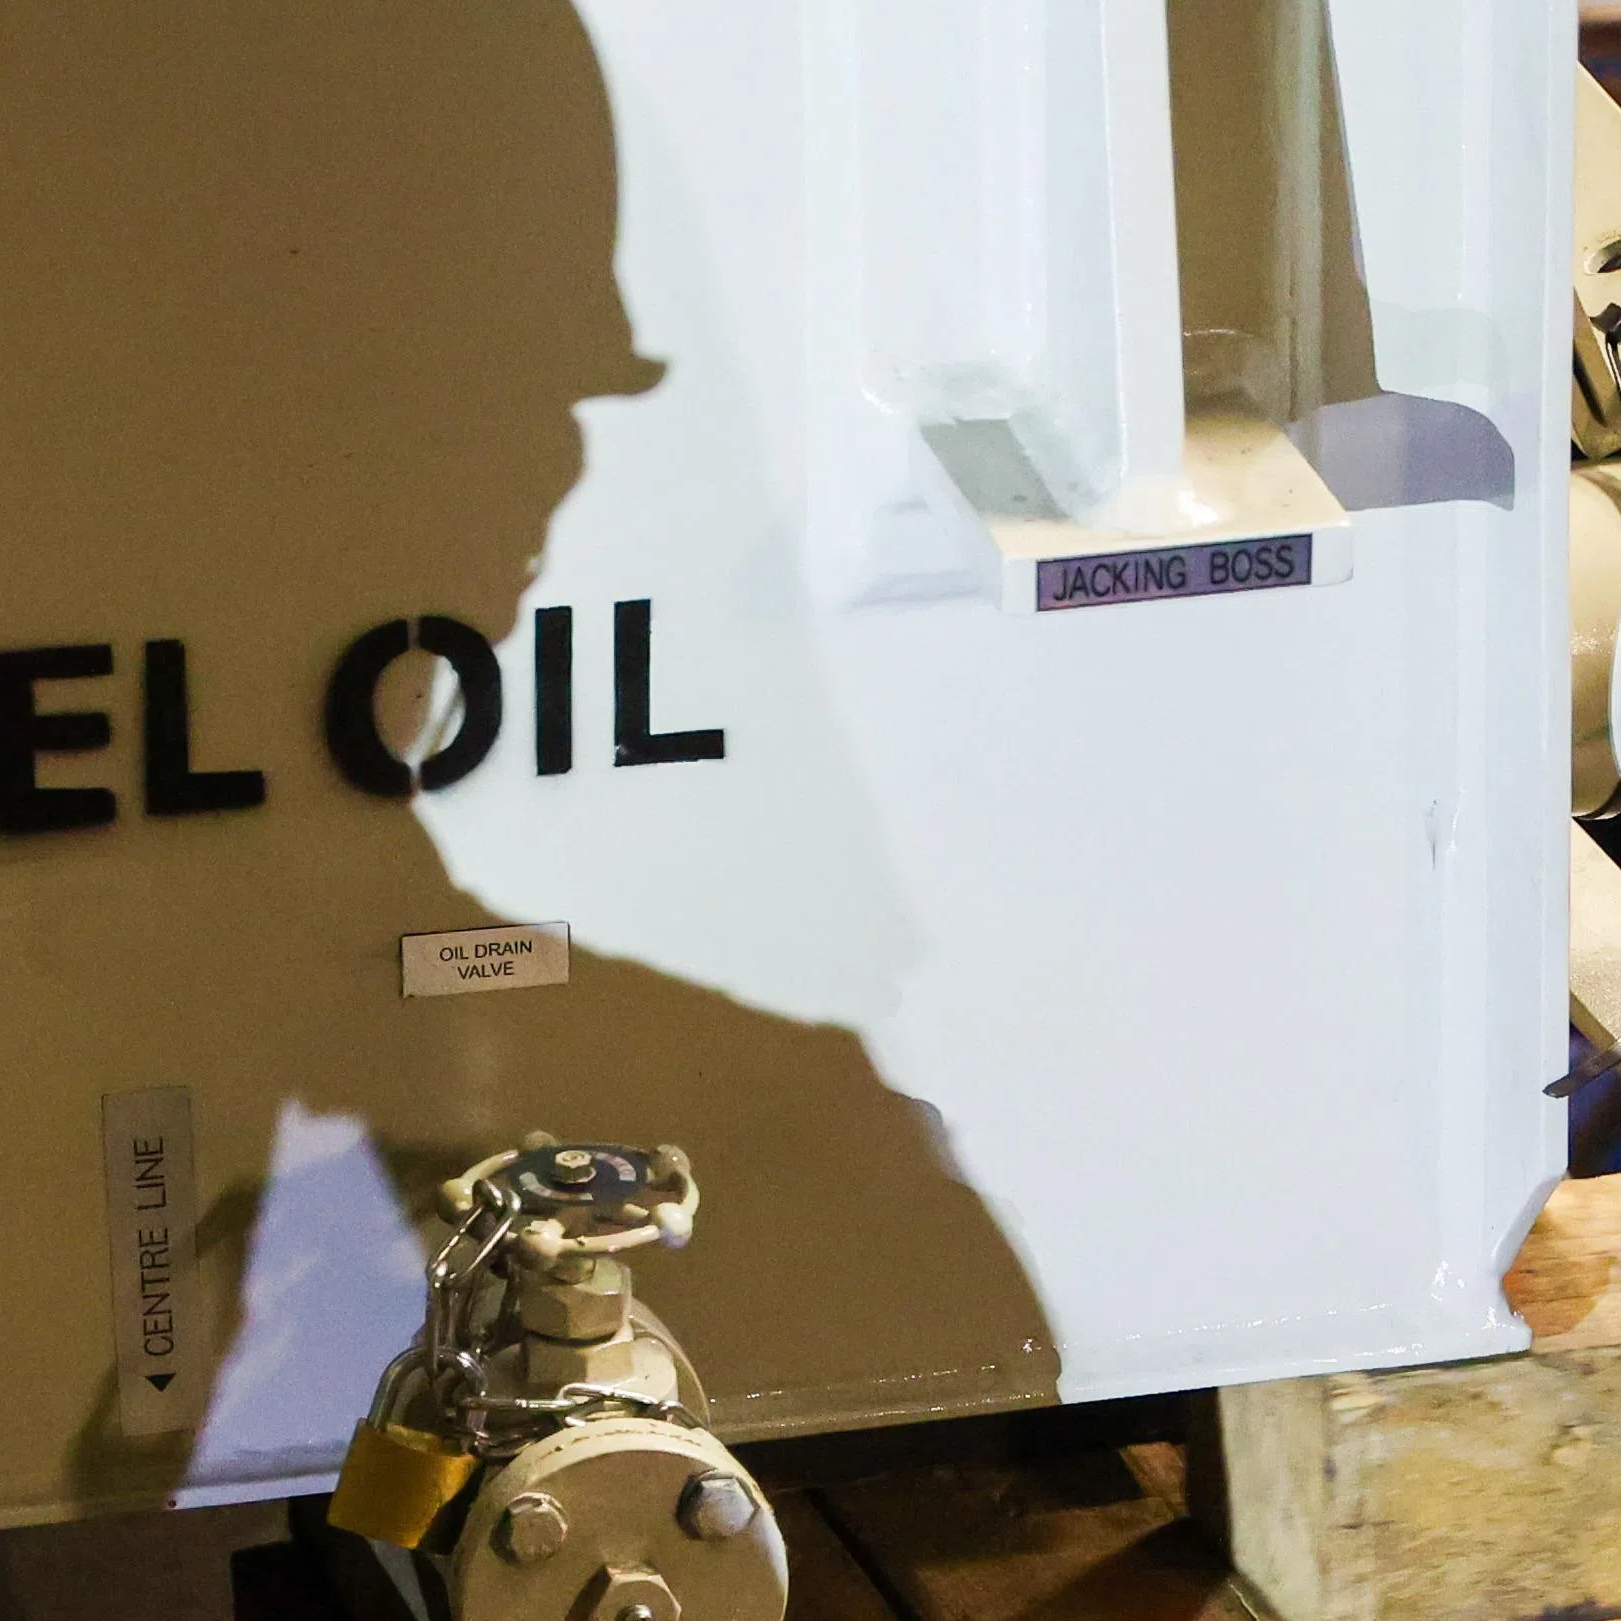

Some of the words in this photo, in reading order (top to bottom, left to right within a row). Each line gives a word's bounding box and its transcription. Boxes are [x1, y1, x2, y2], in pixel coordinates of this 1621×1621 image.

[1053, 555, 1187, 601] JACKING
[1209, 545, 1296, 585] BOSS
[325, 598, 726, 800] OIL
[439, 945, 470, 962] OIL
[474, 940, 533, 959] DRAIN
[457, 961, 515, 980] VALVE
[133, 1135, 167, 1211] LINE
[138, 1226, 176, 1357] CENTRE
